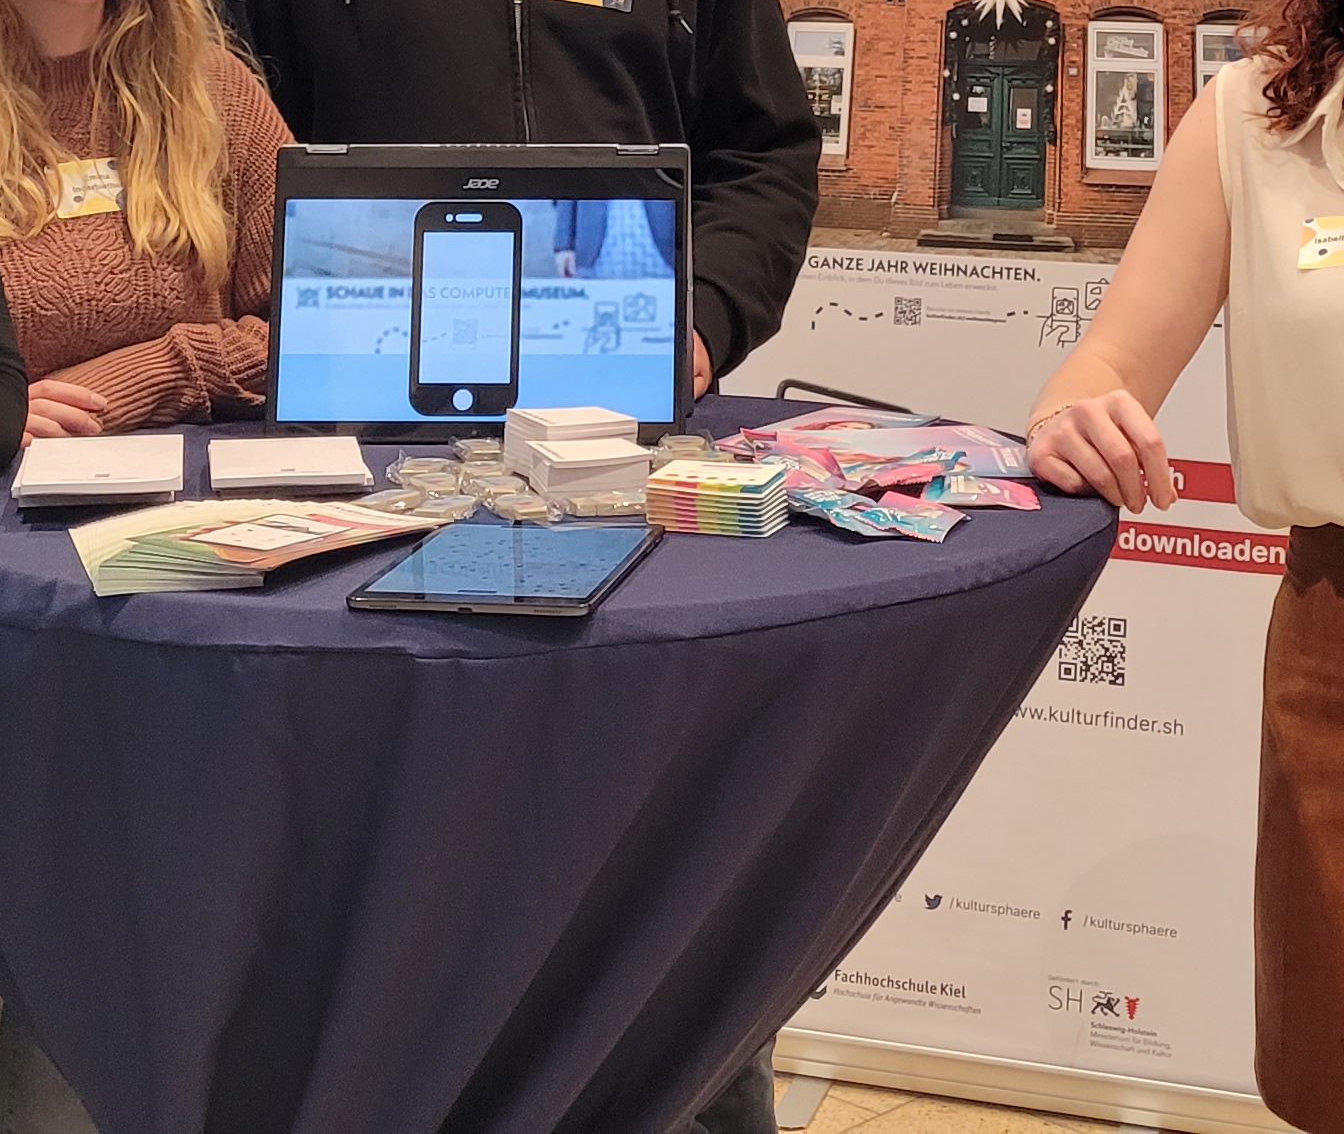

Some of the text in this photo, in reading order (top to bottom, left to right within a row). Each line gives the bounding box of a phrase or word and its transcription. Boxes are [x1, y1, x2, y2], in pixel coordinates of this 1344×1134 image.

[463, 179, 500, 189] acer
[807, 255, 1041, 283] GANZE JAHR WEIHNACHTEN.
[326, 286, 384, 299] SCHAUE
[388, 286, 404, 298] IN
[439, 286, 589, 300] COMPUTEMUSEUM.
[1118, 528, 1286, 564] downloaden
[1015, 706, 1184, 736] ww.kulturfinder.sh
[949, 897, 1040, 920] /kultursphaere
[1083, 916, 1178, 938] /kultursphaere
[835, 969, 966, 998] Fachhochschule Kiel
[1048, 986, 1083, 1013] SH
